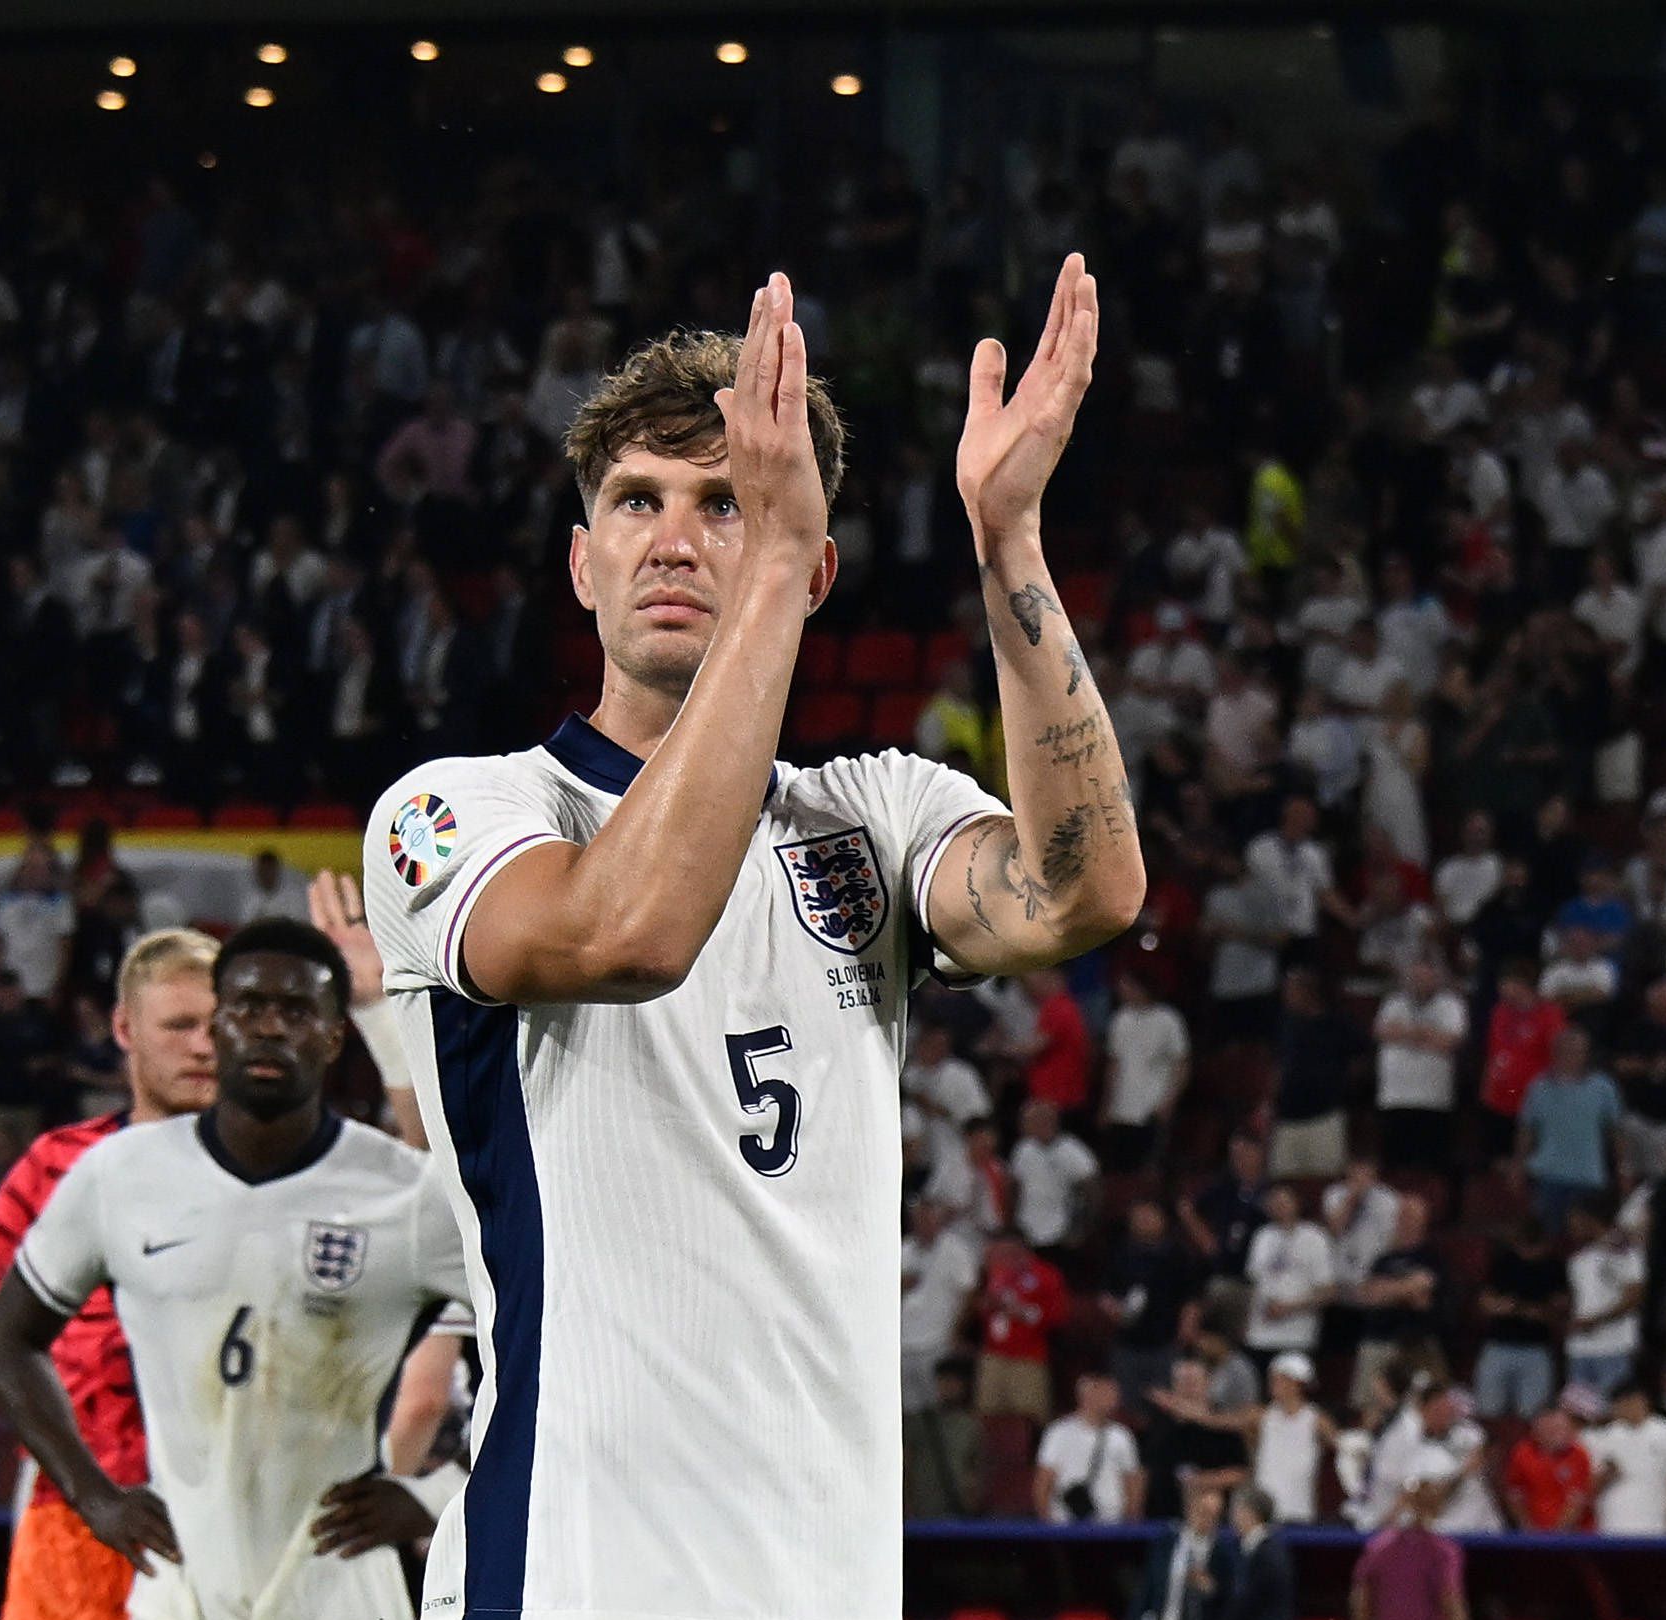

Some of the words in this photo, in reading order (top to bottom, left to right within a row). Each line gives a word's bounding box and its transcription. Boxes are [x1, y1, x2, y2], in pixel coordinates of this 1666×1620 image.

[826, 961, 886, 987] SLOVENIA
[724, 1024, 801, 1177] 5
[220, 1304, 254, 1387] 6
